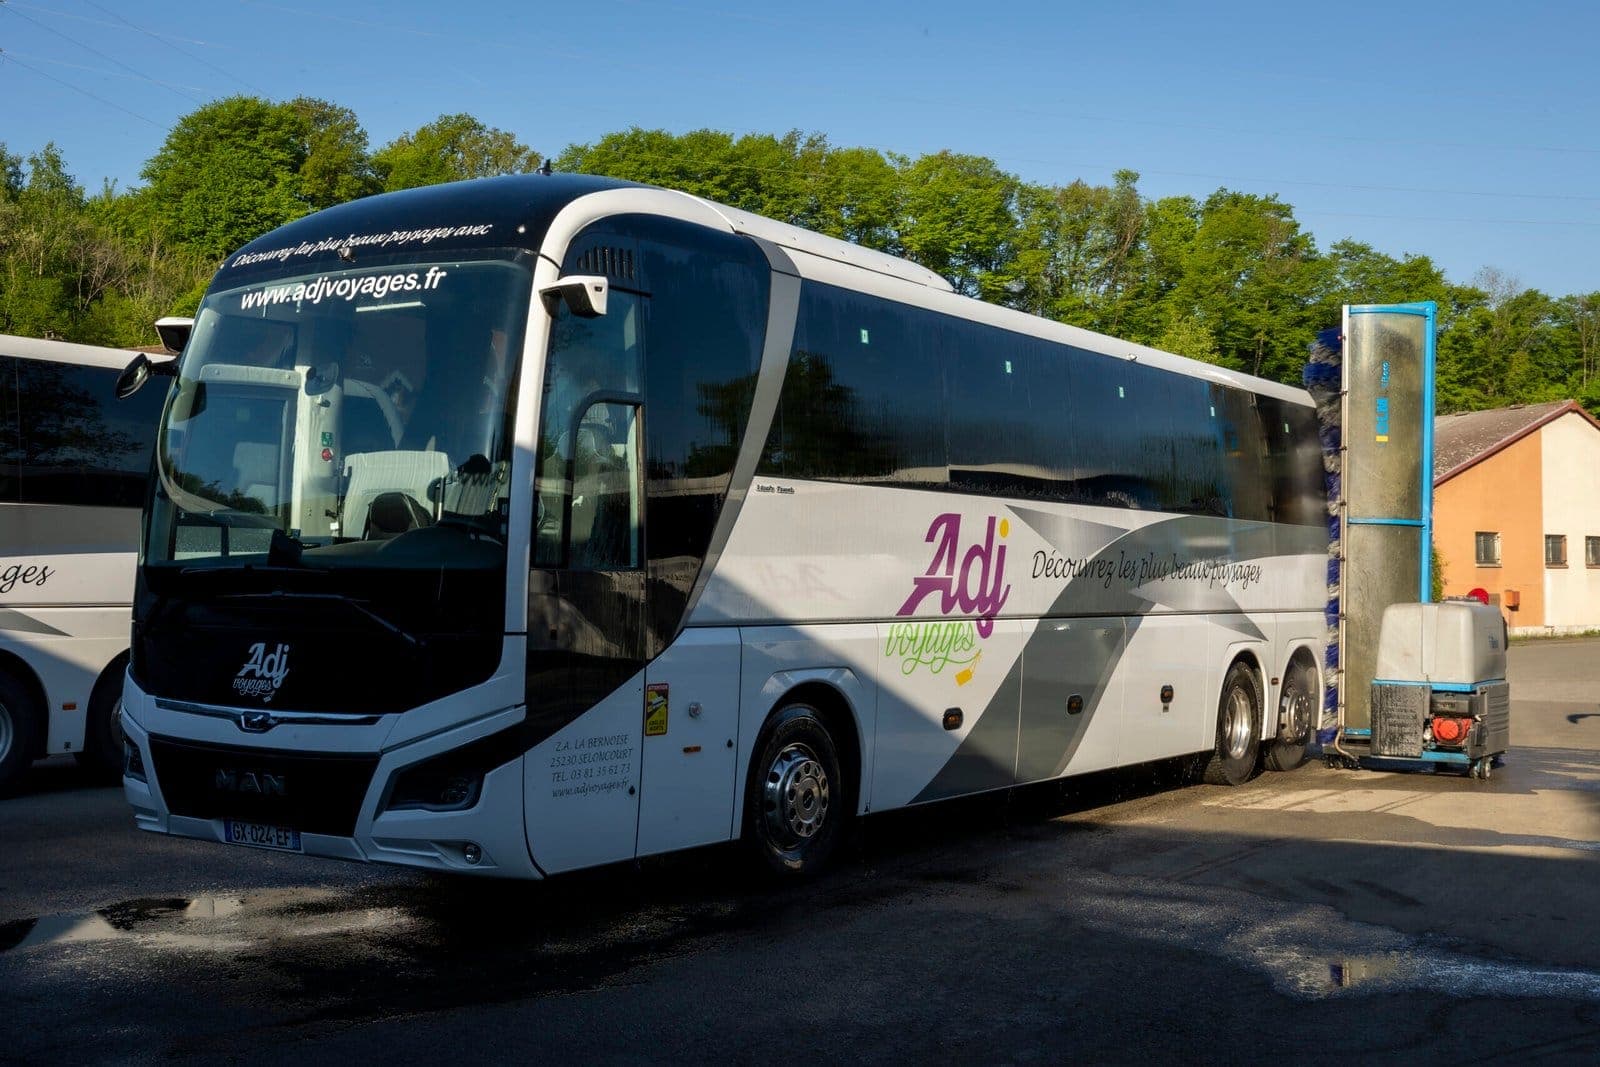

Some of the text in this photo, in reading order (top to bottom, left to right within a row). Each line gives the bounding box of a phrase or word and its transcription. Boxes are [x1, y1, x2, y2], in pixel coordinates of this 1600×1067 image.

[231, 223, 494, 267] Découvrez les plus beaux paysages avec
[240, 266, 448, 311] www.adjvoyages.fr
[0, 563, 56, 594] ges
[894, 512, 1012, 640] Adj
[1031, 549, 1263, 590] Découvrez les plus beaux paysages
[235, 642, 291, 689] Adj
[885, 621, 978, 676] voyages
[575, 738, 586, 750] LA
[577, 748, 633, 765] SELONCOURT
